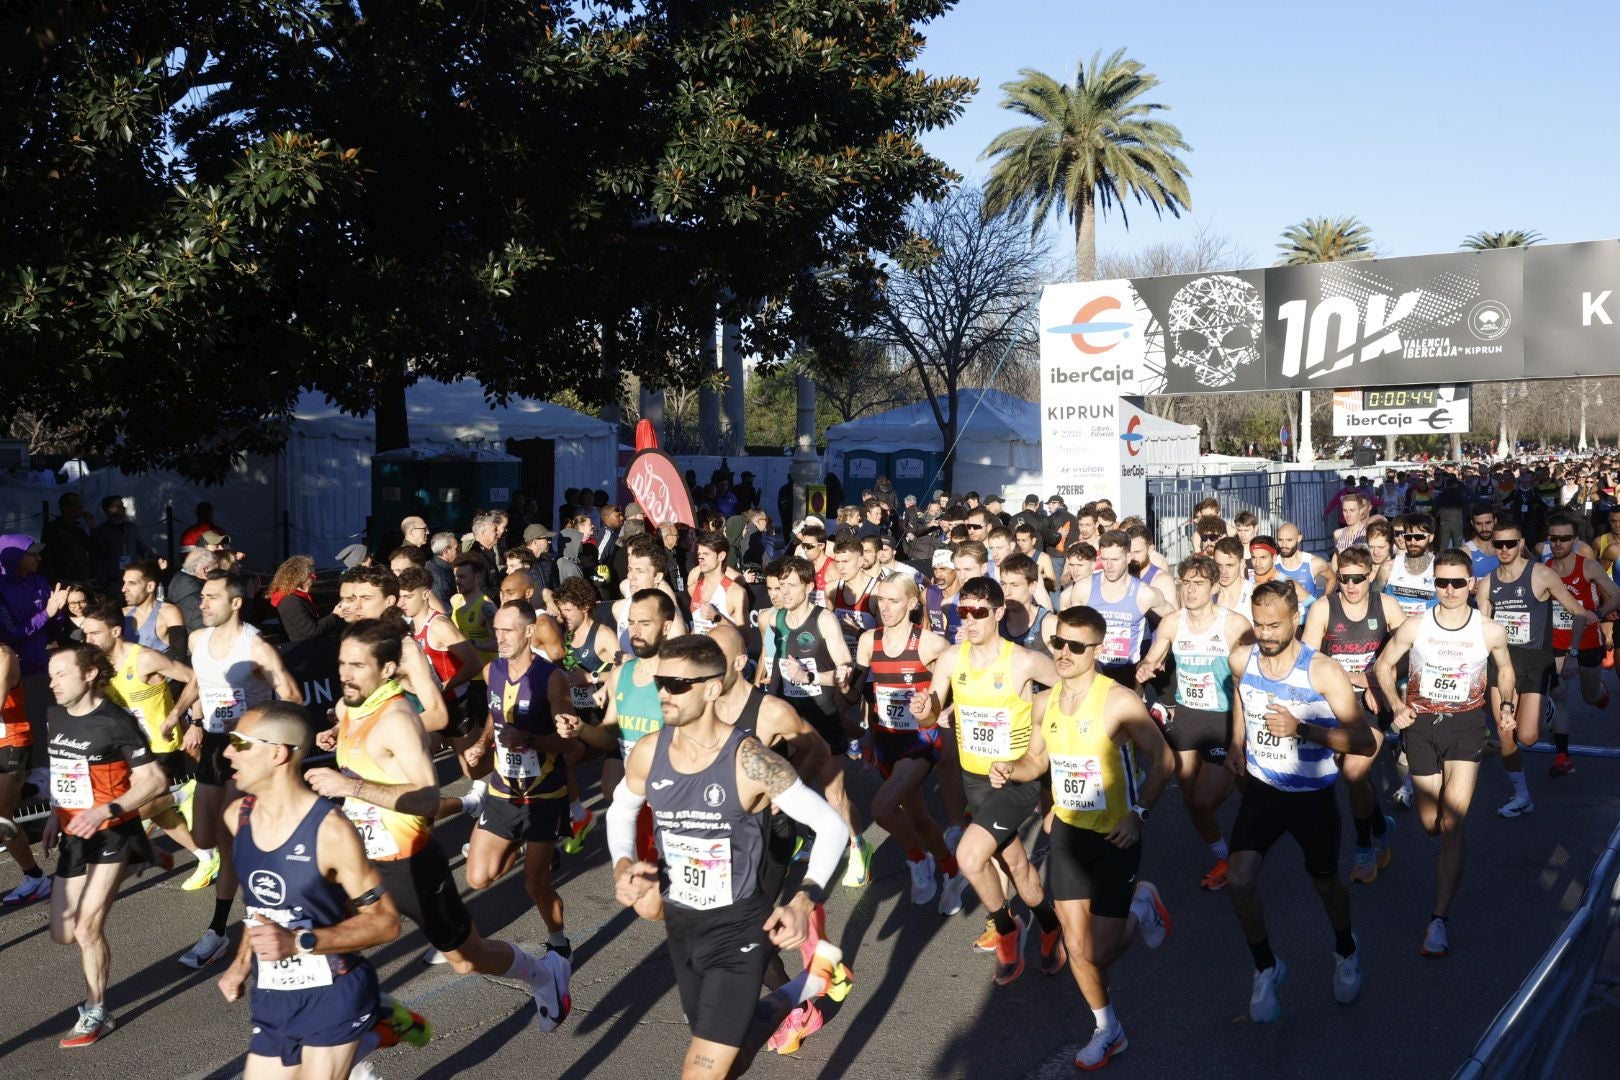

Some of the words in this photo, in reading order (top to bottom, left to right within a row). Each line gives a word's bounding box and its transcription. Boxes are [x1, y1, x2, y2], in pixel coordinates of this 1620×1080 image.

[1278, 288, 1422, 379] 10K
[1404, 338, 1450, 350] VALENCIA
[1403, 346, 1458, 359] IBERCAJA
[1465, 346, 1502, 355] KIPRUN
[1051, 365, 1134, 385] iberCaja
[1370, 391, 1433, 407] 0:00:44
[1048, 404, 1114, 420] KIPRUN
[1347, 413, 1412, 428] iberCaja
[1122, 465, 1145, 478] iberCaja
[1057, 485, 1084, 495] 226ERS
[1505, 625, 1518, 635] 631
[1434, 678, 1457, 690] 654
[1186, 687, 1204, 698] 663
[1429, 691, 1460, 700] KIPRUN
[216, 706, 233, 718] 665
[886, 705, 904, 717] 572
[973, 728, 994, 742] 598
[1257, 731, 1280, 747] 620
[970, 746, 1000, 754] KIPRUN
[1255, 750, 1286, 760] KIPRUN
[506, 753, 522, 765] 619
[57, 780, 76, 793] 525
[1064, 779, 1086, 794] 667
[1063, 799, 1095, 808] KIPRUN
[684, 866, 706, 888] 591
